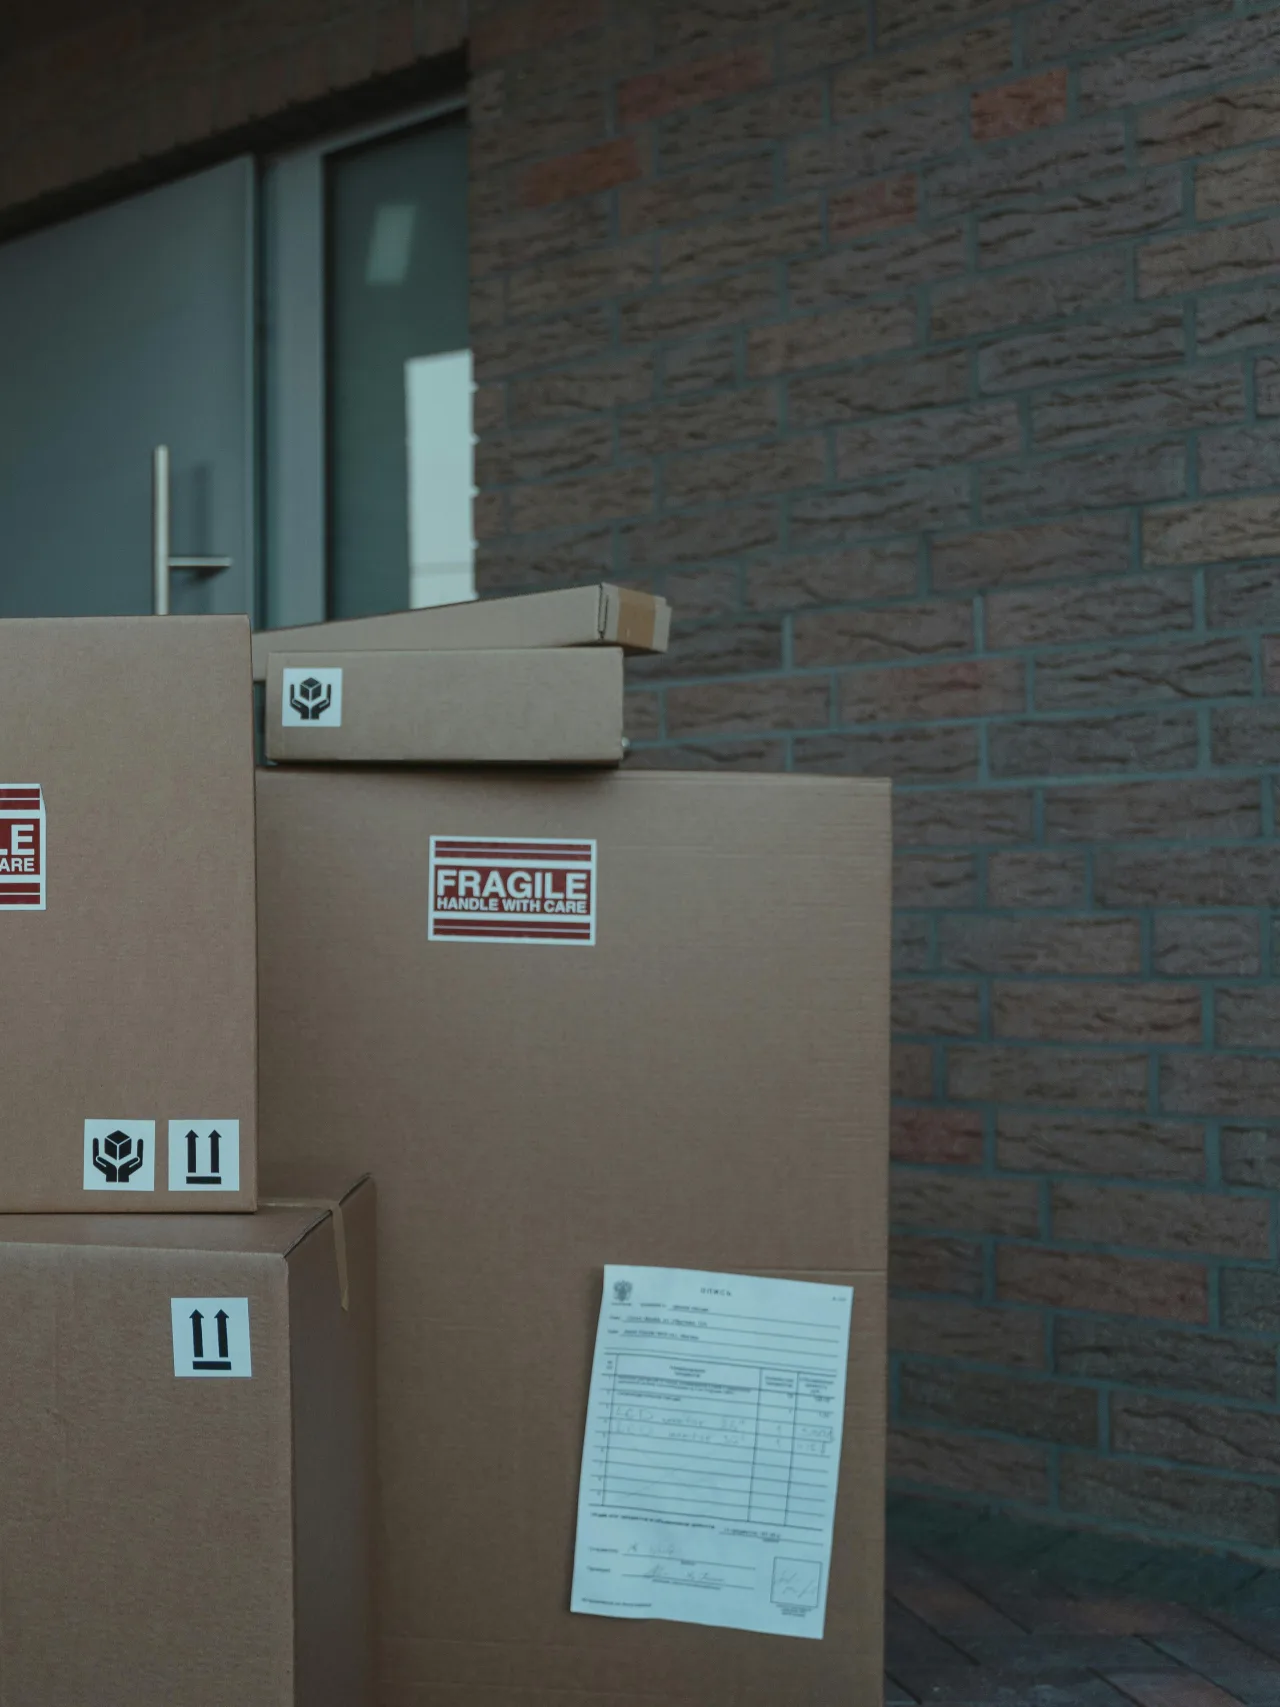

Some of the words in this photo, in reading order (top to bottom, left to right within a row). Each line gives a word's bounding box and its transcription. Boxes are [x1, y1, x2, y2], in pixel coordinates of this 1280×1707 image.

[436, 869, 588, 900] FRAGILE
[437, 897, 499, 911] HANDLE
[502, 898, 541, 912] WITH
[544, 899, 587, 914] CARE
